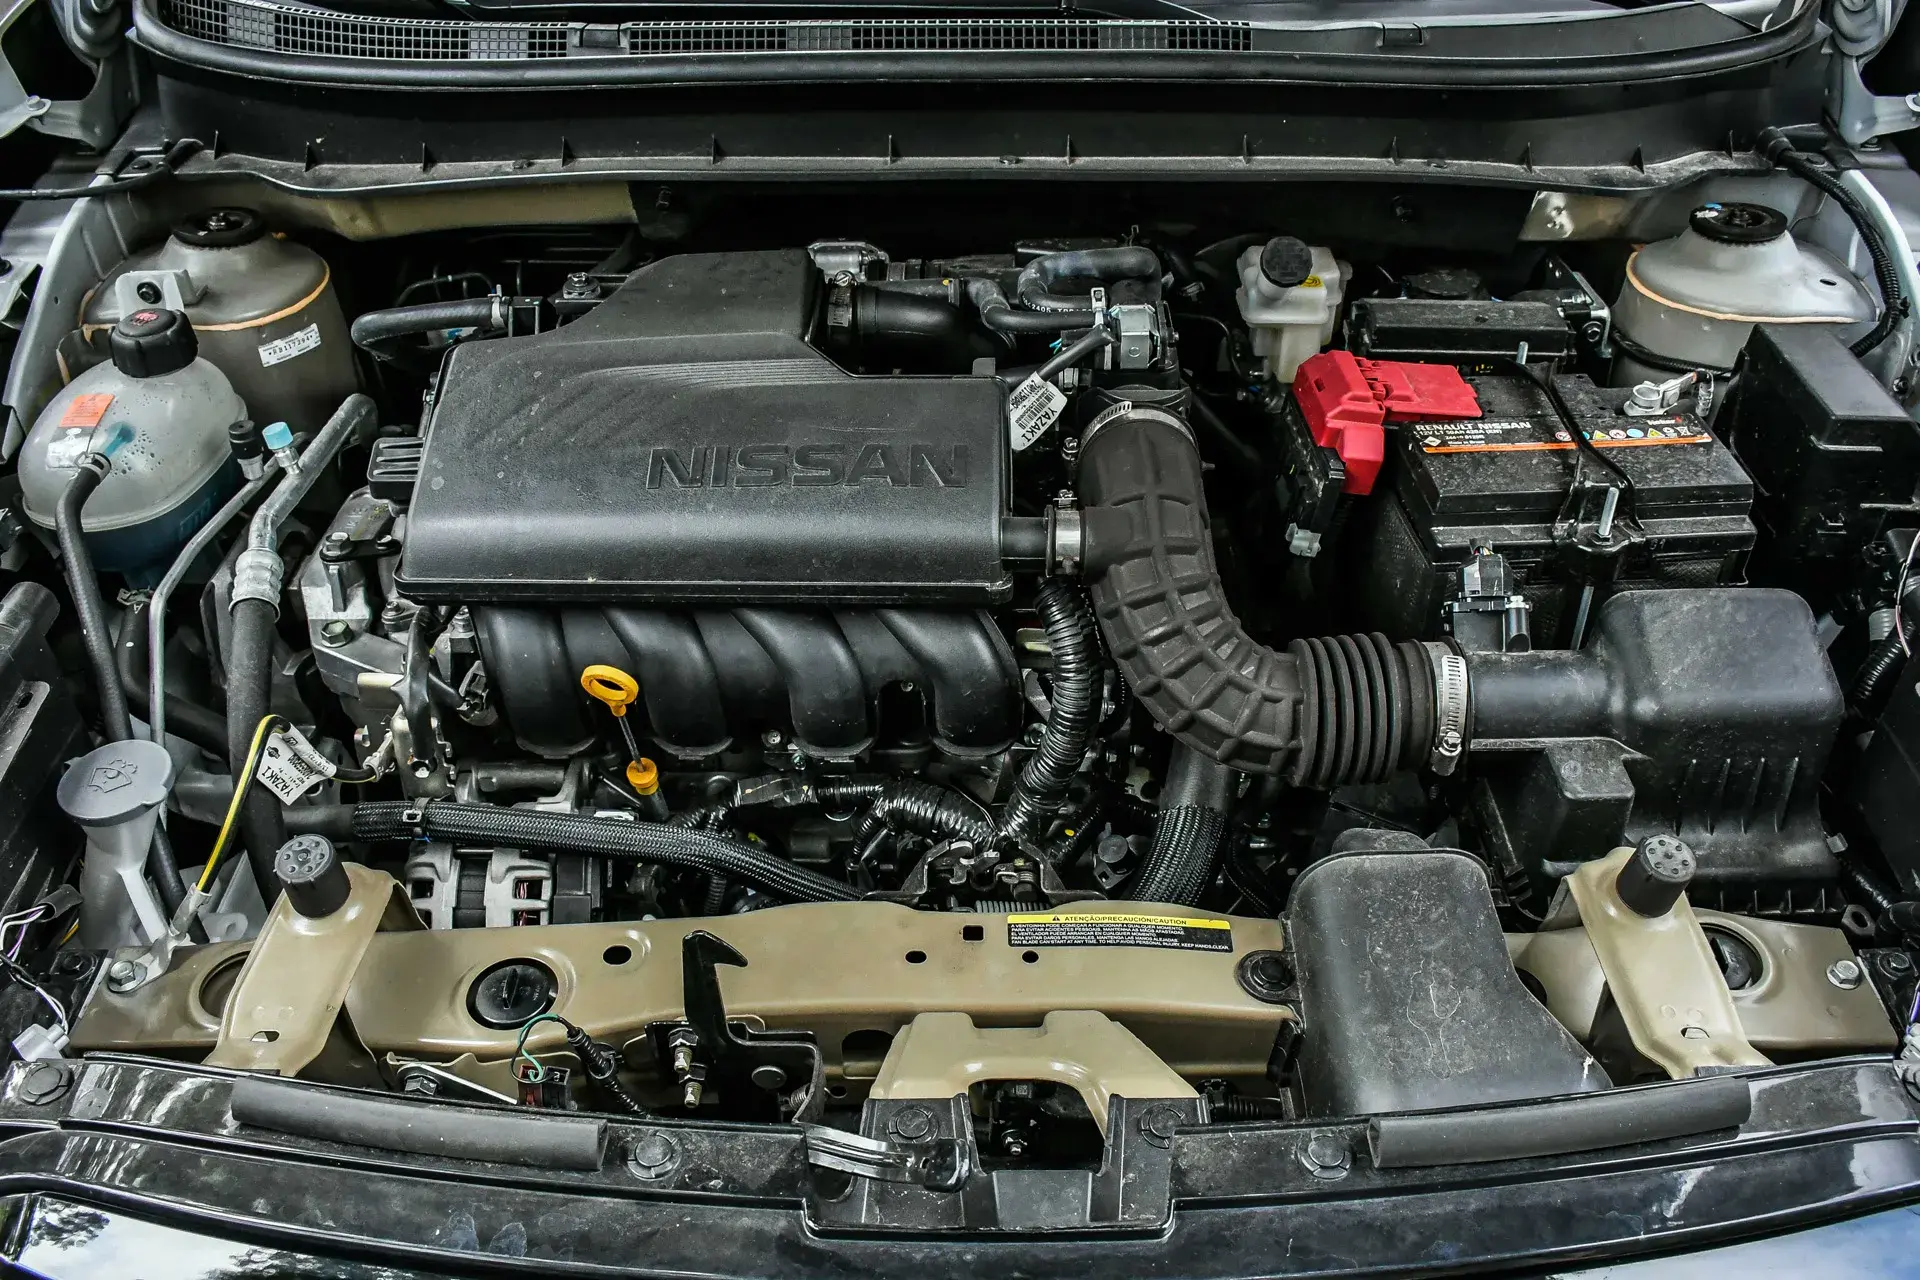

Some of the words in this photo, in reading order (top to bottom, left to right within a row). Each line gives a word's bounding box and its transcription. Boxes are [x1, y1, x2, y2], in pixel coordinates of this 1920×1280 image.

[1021, 407, 1058, 442] YAZAKI
[646, 442, 968, 489] NISSAN
[262, 766, 293, 797] YAZAKI
